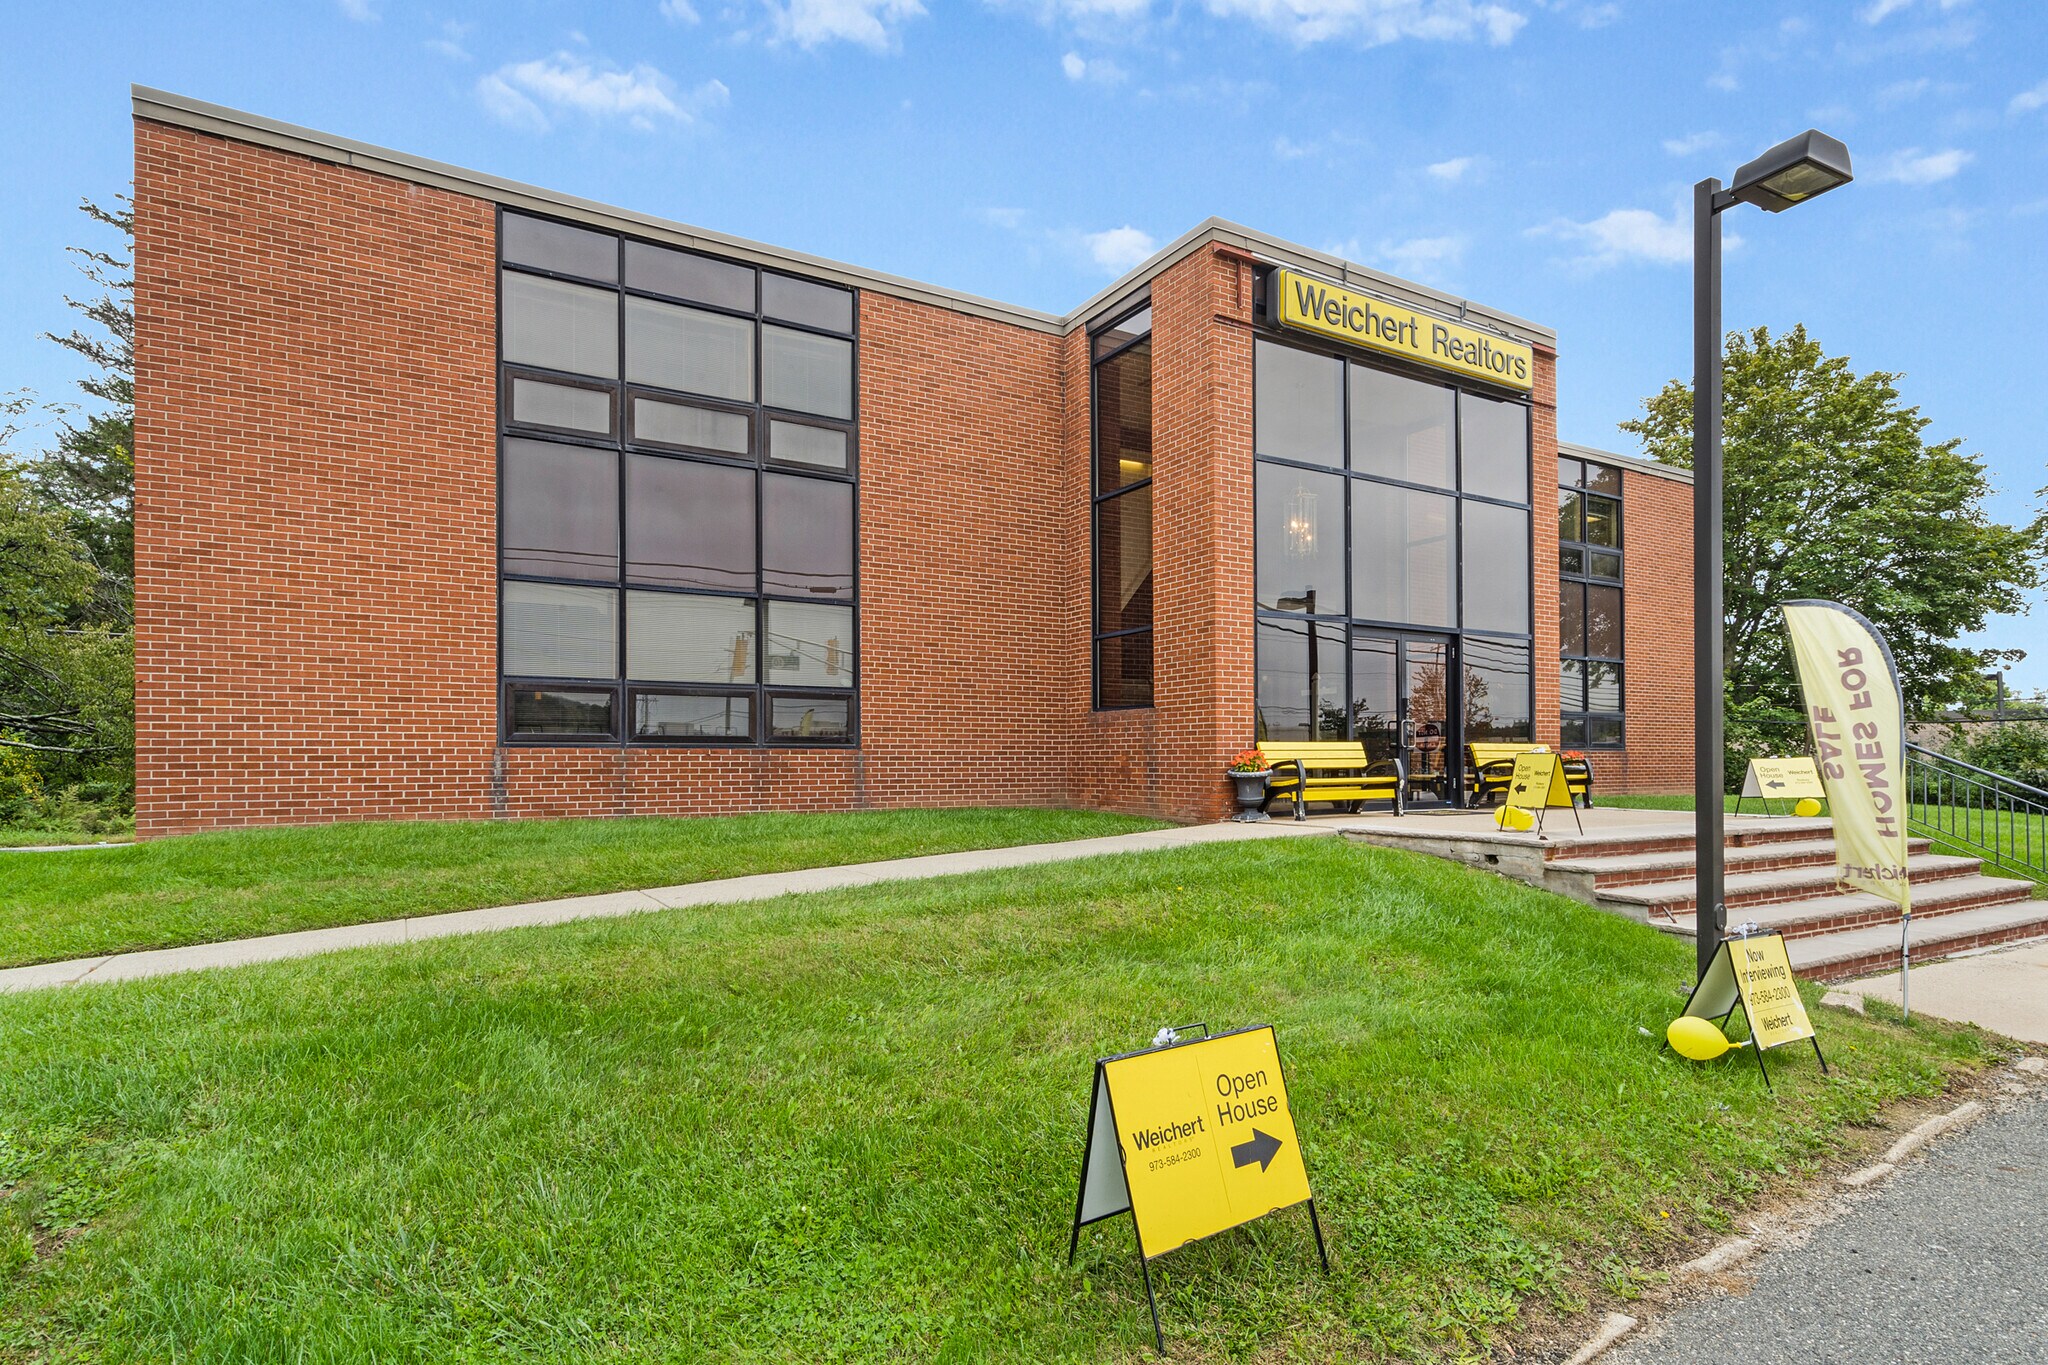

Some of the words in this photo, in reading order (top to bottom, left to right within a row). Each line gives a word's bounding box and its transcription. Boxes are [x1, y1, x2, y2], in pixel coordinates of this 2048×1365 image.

[1295, 281, 1418, 348] Weichert
[1432, 323, 1527, 379] Realtors
[1515, 772, 1531, 780] House
[1518, 764, 1531, 772] Open
[1746, 948, 1764, 963] Now
[1761, 1012, 1793, 1031] Weichert
[1217, 1070, 1268, 1099] Open
[1217, 1095, 1278, 1126] House
[1132, 1115, 1205, 1151] Weichert
[1148, 1147, 1201, 1172] 973-584-2300
